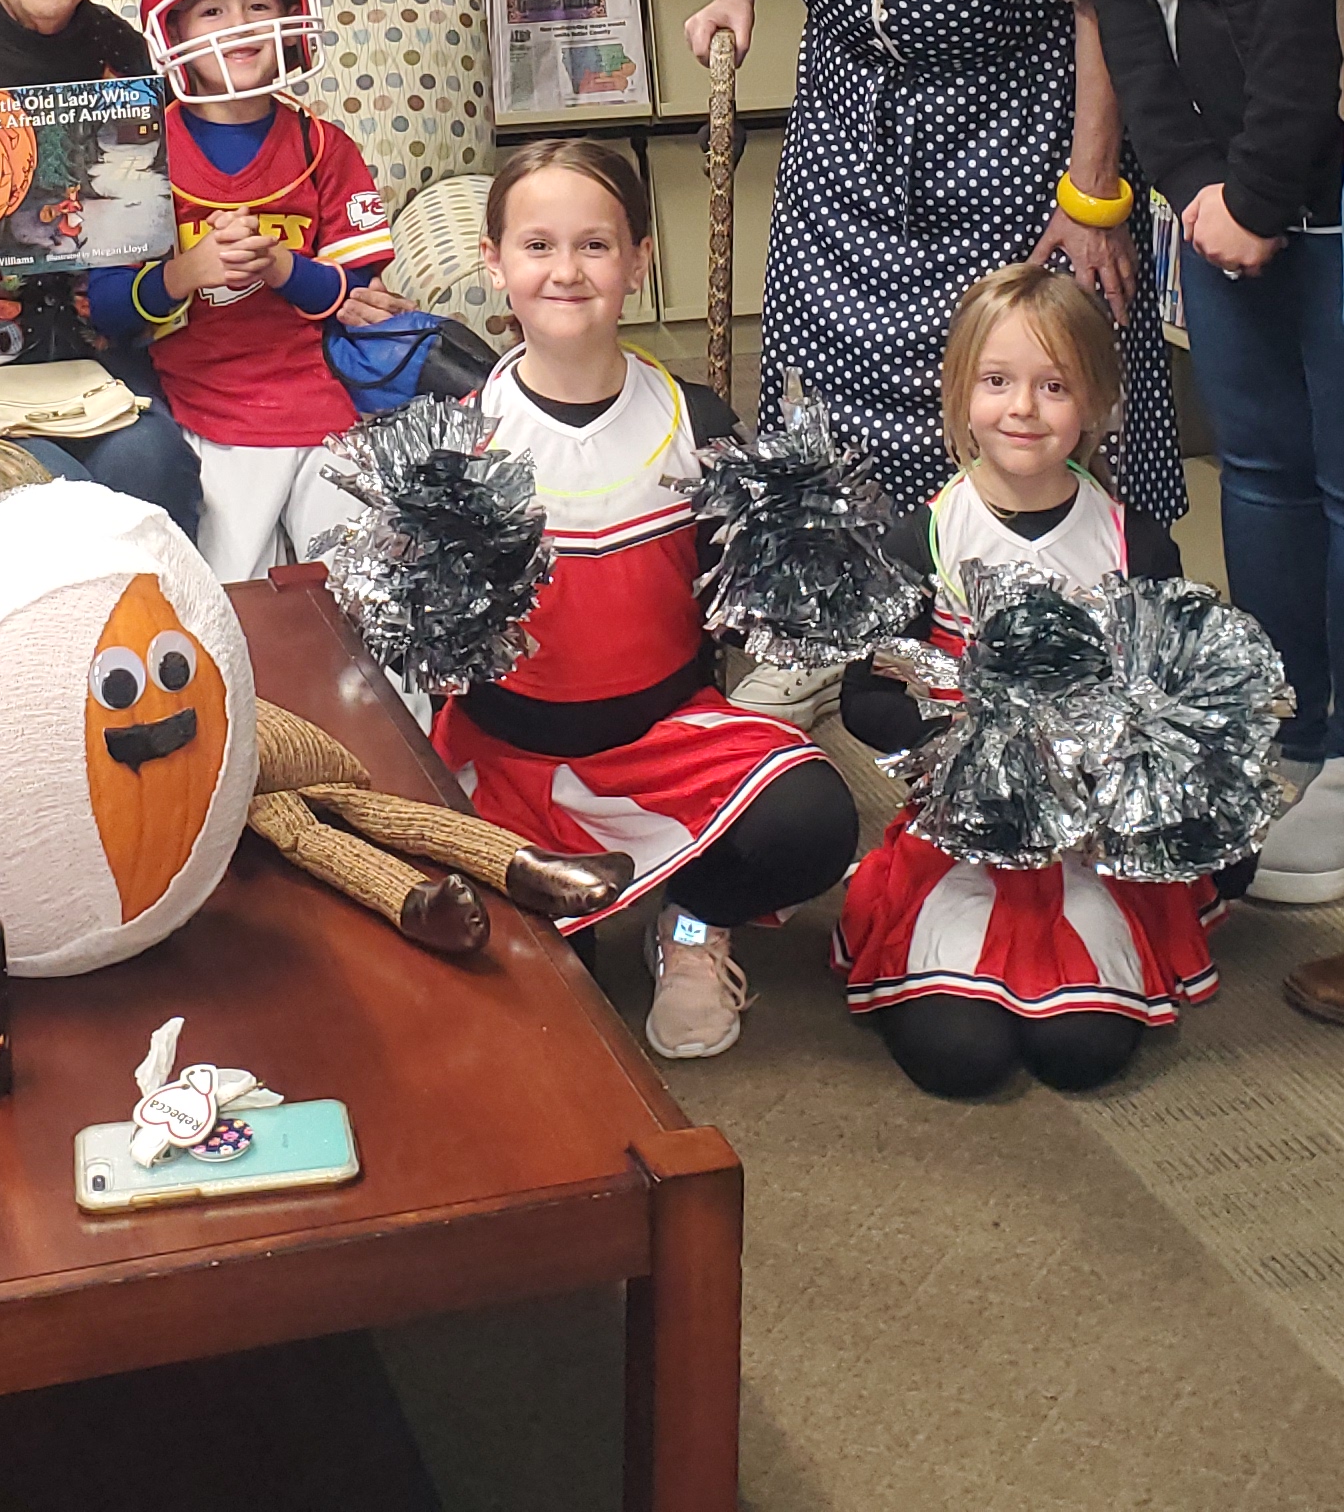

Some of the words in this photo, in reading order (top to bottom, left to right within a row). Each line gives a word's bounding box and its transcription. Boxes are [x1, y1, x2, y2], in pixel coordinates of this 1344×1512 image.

[24, 92, 55, 111] Old
[58, 89, 99, 111] Lady
[101, 88, 141, 104] Who
[5, 108, 56, 130] Afraid
[58, 108, 77, 124] of
[78, 103, 152, 125] Anything
[81, 249, 92, 259] by
[92, 245, 122, 258] Megan
[123, 243, 149, 255] Lloyd
[149, 1098, 204, 1132] Rebecca
